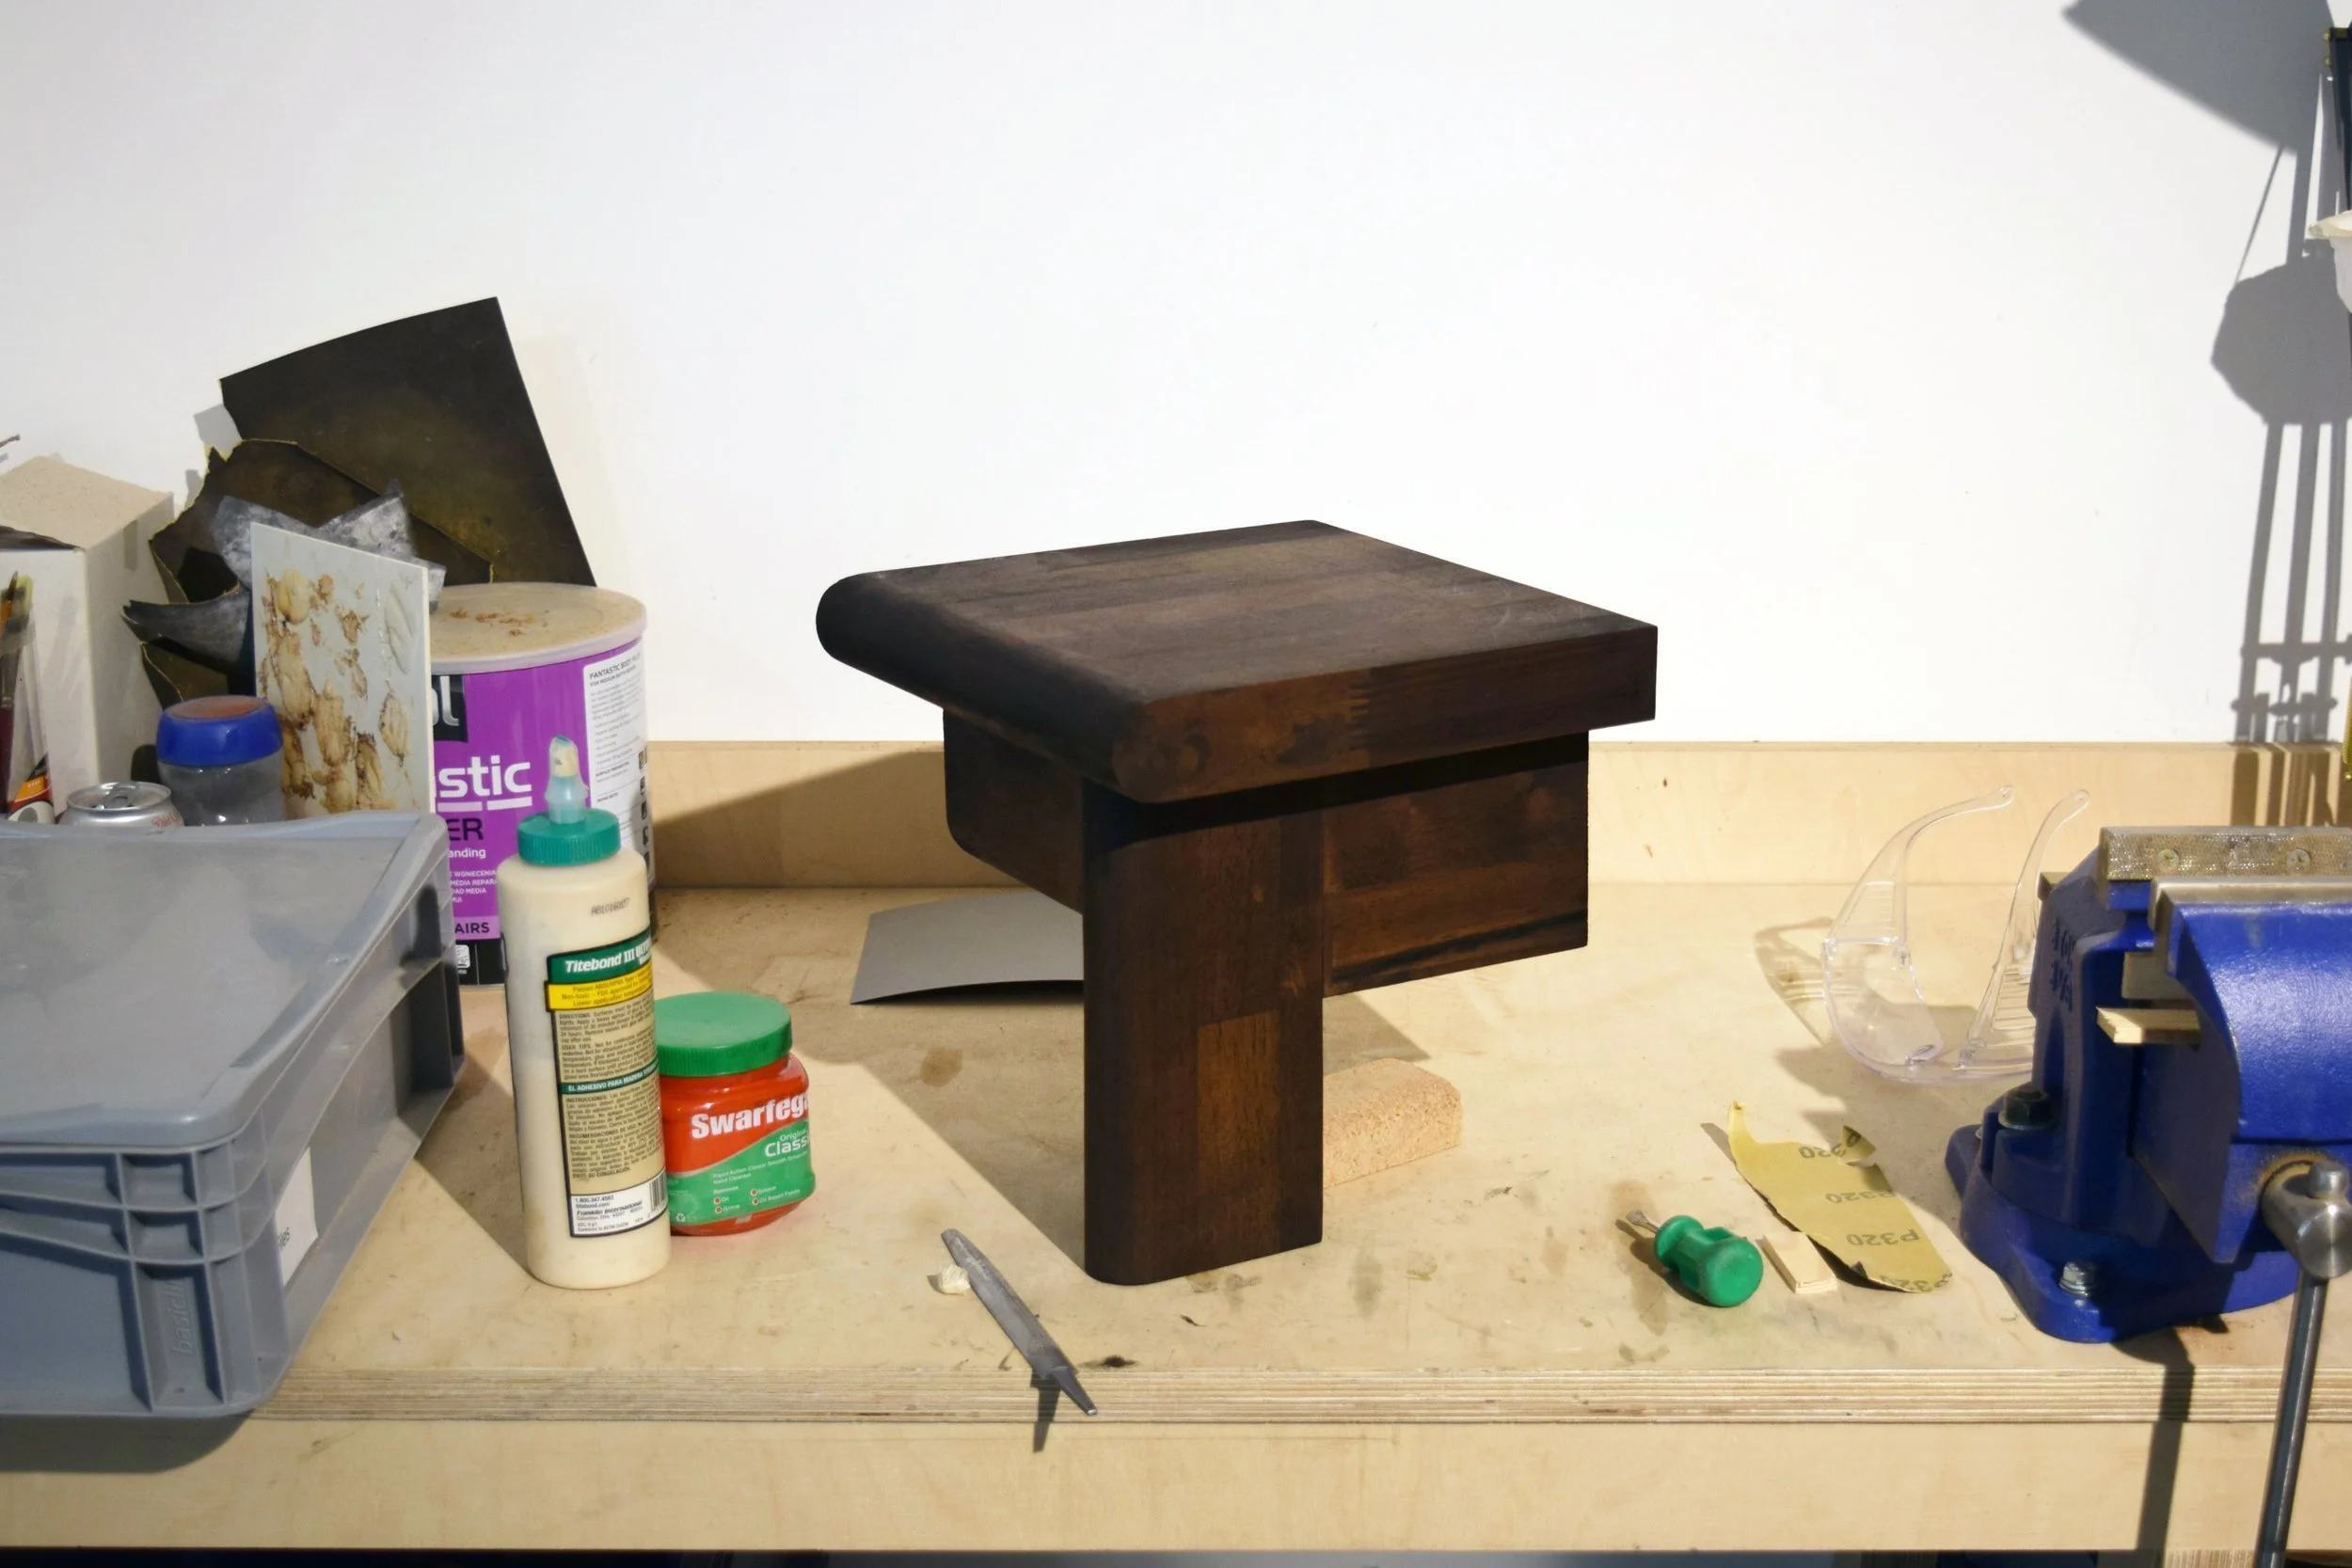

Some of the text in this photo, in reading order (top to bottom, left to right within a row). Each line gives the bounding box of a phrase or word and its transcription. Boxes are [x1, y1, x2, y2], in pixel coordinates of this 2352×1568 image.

[434, 755, 532, 798] stic
[454, 922, 490, 934] AIRS
[565, 952, 623, 974] Titebond
[624, 948, 635, 963] III
[1825, 1190, 1896, 1204] P320
[1846, 1227, 1920, 1246] P320
